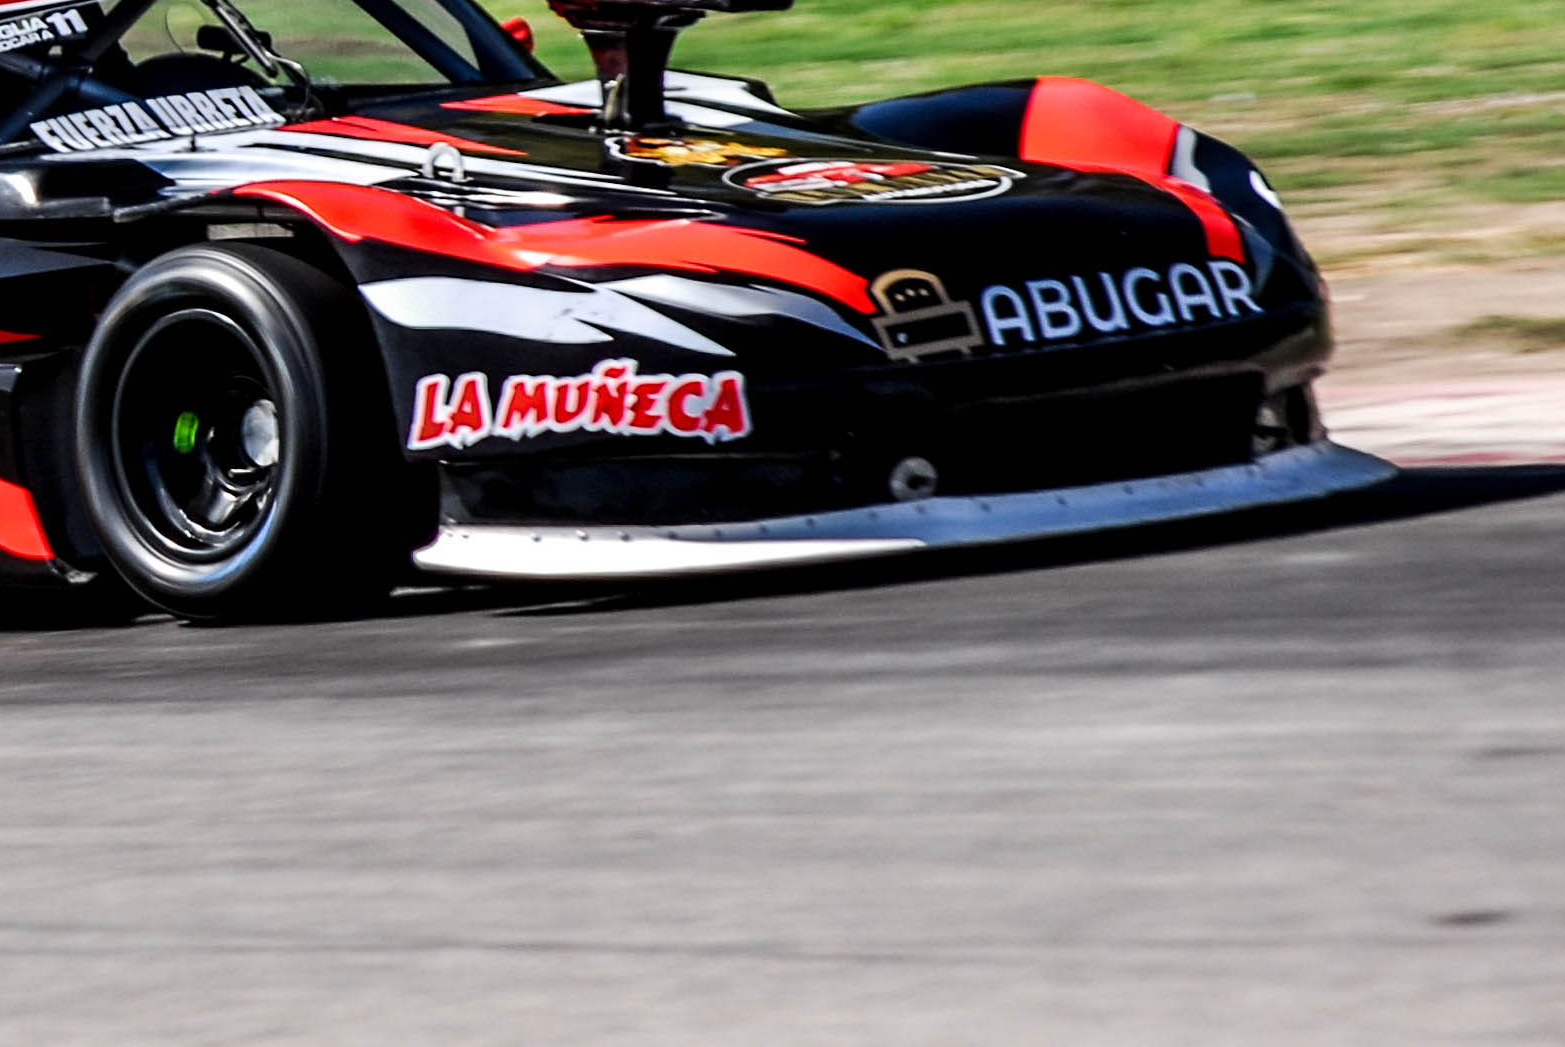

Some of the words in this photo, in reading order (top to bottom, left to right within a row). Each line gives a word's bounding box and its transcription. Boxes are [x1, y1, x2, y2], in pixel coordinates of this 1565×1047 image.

[46, 8, 89, 36] 11
[29, 101, 172, 152] FUERZA
[146, 85, 287, 136] URRETA
[980, 260, 1265, 346] ABUGAR
[413, 377, 485, 444] LA
[497, 364, 748, 437] MUÑECA
